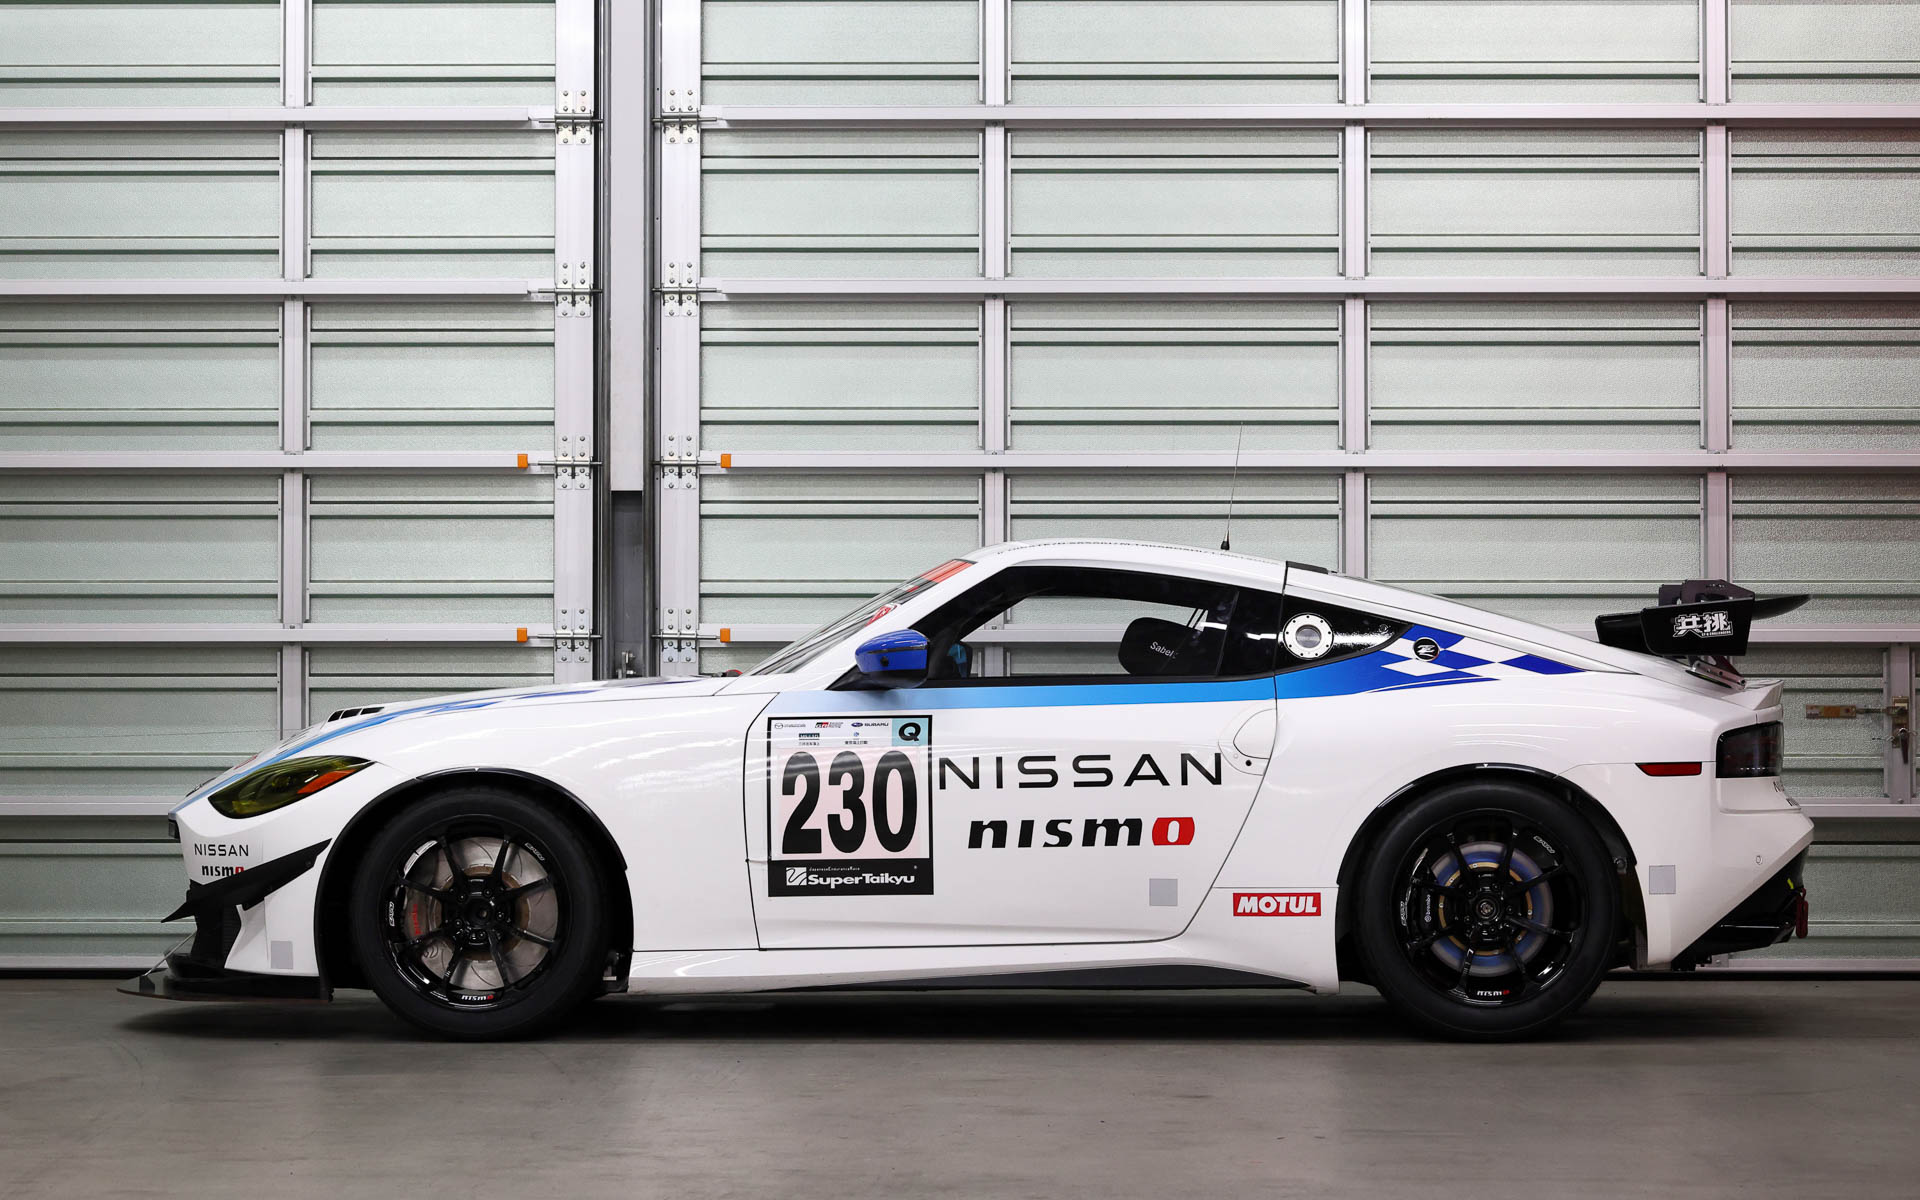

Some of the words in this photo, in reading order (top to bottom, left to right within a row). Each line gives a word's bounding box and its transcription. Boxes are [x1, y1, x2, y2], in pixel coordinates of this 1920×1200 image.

[898, 722, 922, 742] Q
[939, 752, 1222, 790] NISSAN
[782, 750, 917, 854] 230
[968, 817, 1195, 848] nismo
[194, 843, 249, 857] NISSAN
[1237, 896, 1317, 913] MOTUL
